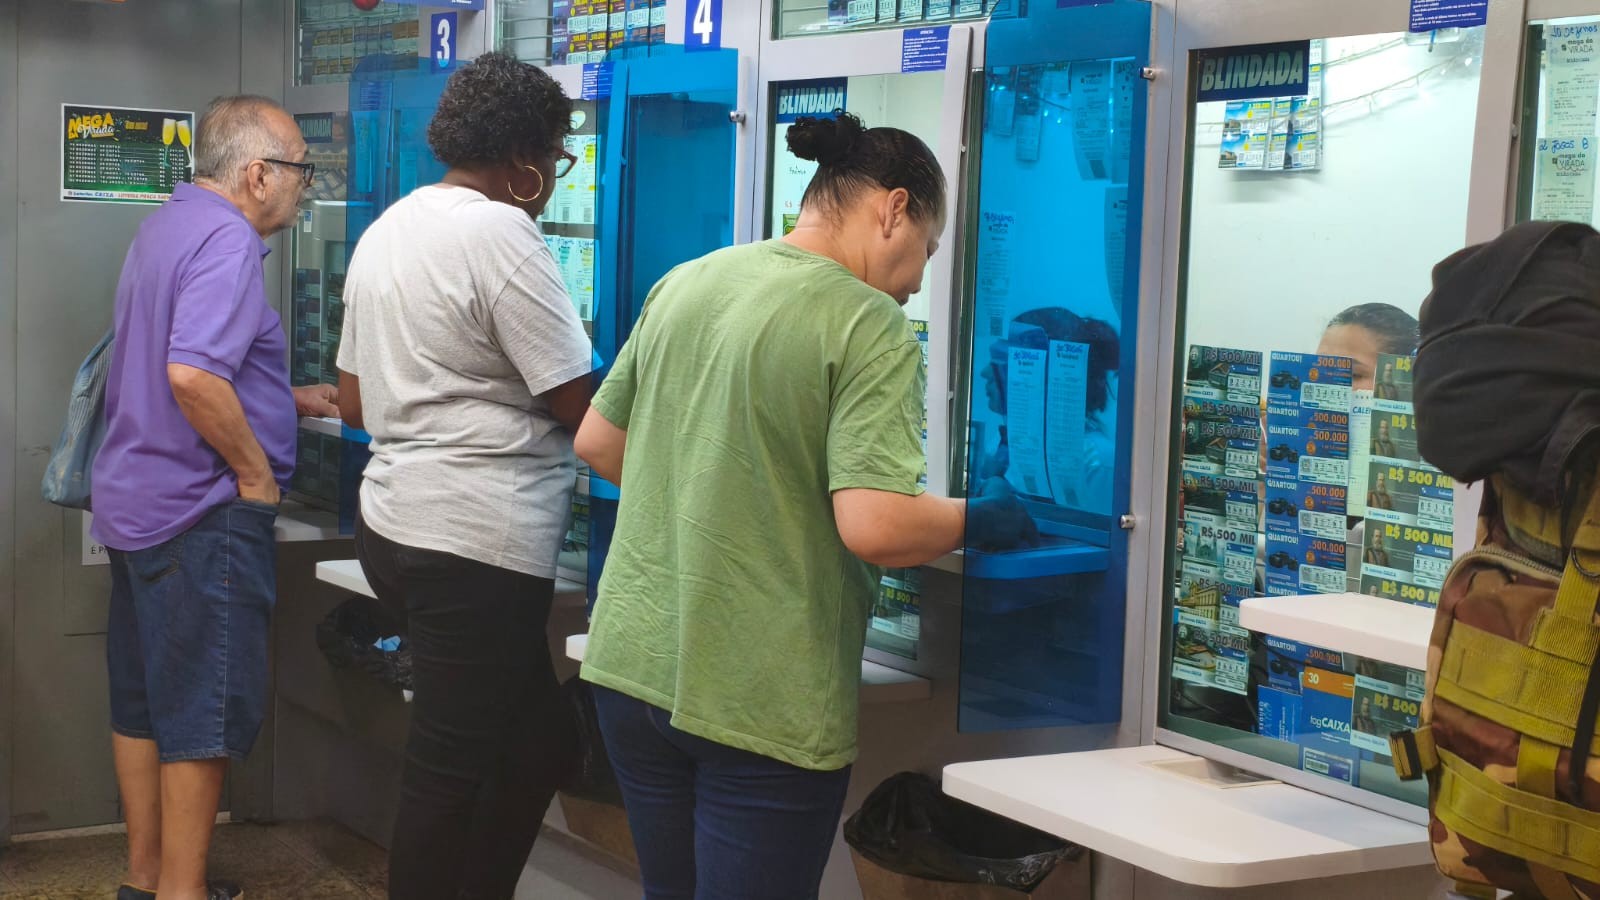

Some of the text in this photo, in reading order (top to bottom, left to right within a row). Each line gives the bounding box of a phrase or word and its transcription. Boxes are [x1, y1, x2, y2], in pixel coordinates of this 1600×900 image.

[693, 0, 712, 44] 4
[437, 18, 450, 68] 3
[1201, 50, 1304, 91] BLINDADA
[778, 86, 844, 115] BLINDADA
[68, 112, 114, 133] MEGA
[1396, 356, 1411, 372] R$
[1217, 404, 1239, 416] 500
[1241, 407, 1257, 418] MIL
[1314, 412, 1347, 424] 500.000
[1391, 414, 1407, 430] R$
[1314, 430, 1347, 442] 500.000
[1388, 467, 1404, 482] R$
[1408, 470, 1433, 486] 500
[1238, 480, 1256, 493] MIL
[1312, 486, 1345, 498] 500.000
[1217, 529, 1237, 542] 500
[1240, 533, 1256, 546] MIL
[1385, 524, 1401, 540] R$
[1404, 527, 1429, 544] 500
[1382, 580, 1398, 596] R$
[1401, 584, 1425, 601] 500
[1308, 673, 1319, 685] 30
[1374, 693, 1418, 716] R$ 500
